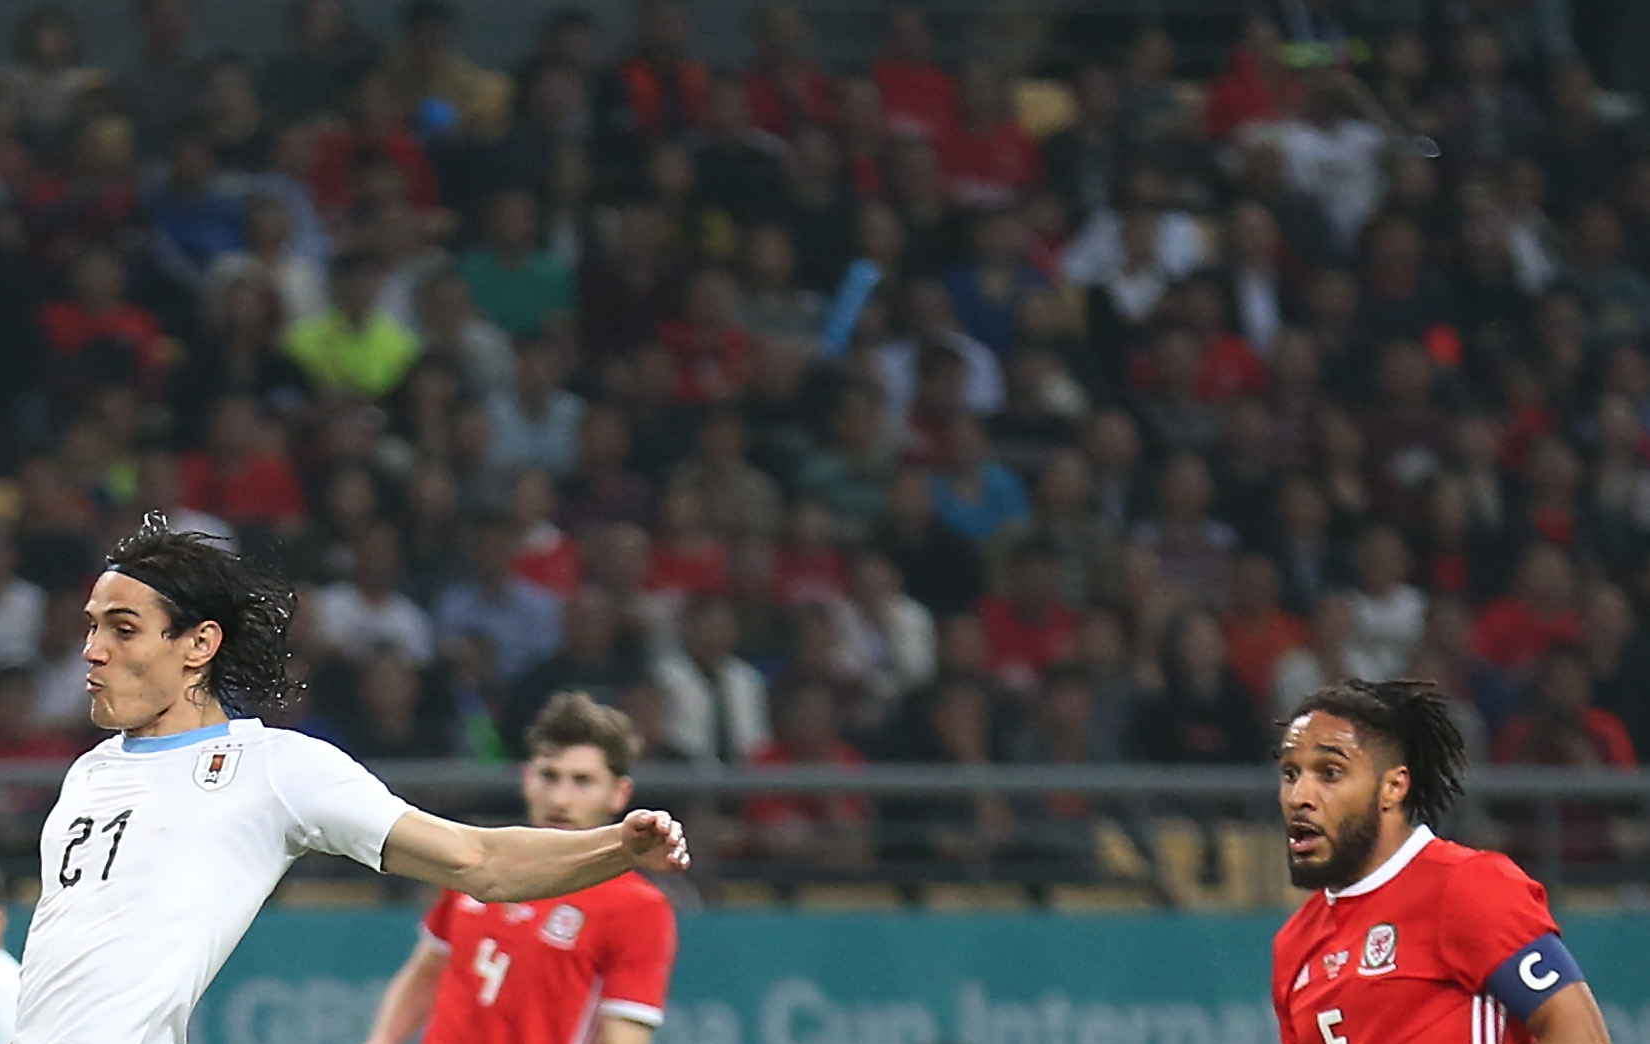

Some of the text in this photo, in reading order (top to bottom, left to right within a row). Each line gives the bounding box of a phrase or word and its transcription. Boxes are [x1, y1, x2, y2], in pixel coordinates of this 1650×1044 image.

[59, 808, 134, 889] 21
[473, 936, 512, 1008] 4
[1518, 950, 1561, 991] C
